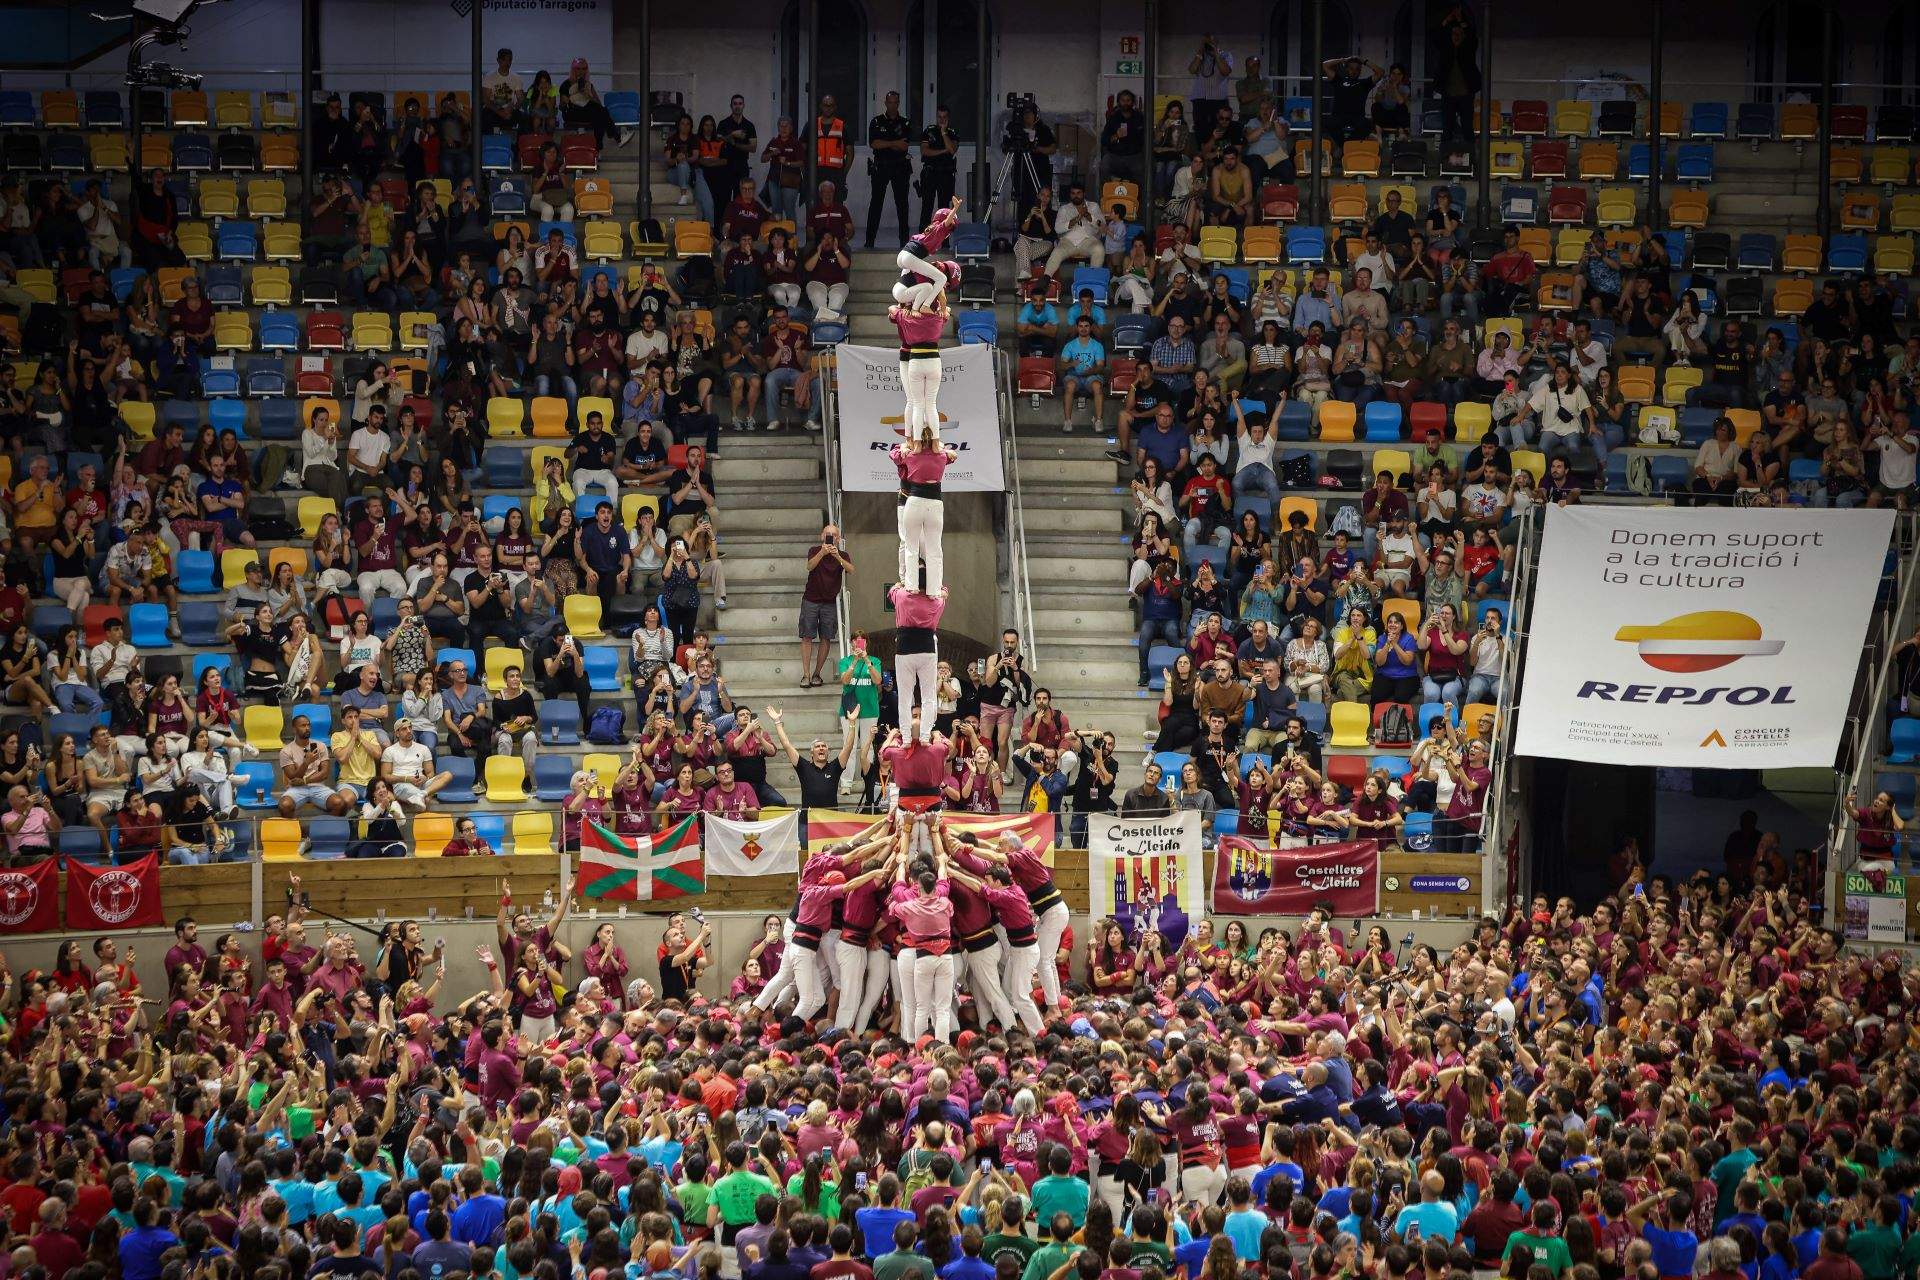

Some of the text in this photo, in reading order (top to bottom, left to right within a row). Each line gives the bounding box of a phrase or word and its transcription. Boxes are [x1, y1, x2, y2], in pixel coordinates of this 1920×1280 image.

[540, 0, 597, 12] Tarragona
[865, 364, 900, 373] Done
[1611, 529, 1824, 550] Donem suport
[1606, 550, 1800, 568] a la tradició i
[1603, 567, 1745, 588] la cultura
[1576, 680, 1797, 706] REPSOL
[1569, 727, 1611, 738] principal
[1570, 720, 1632, 731] Patrocinador
[1568, 733, 1607, 743] Concurs
[1624, 739, 1663, 747] Castells
[1107, 825, 1184, 842] Castellers
[1114, 839, 1181, 856] de Lleida
[1295, 865, 1364, 878] Castellers
[1301, 875, 1360, 890] de Lleida
[1848, 876, 1903, 895] SORDA
